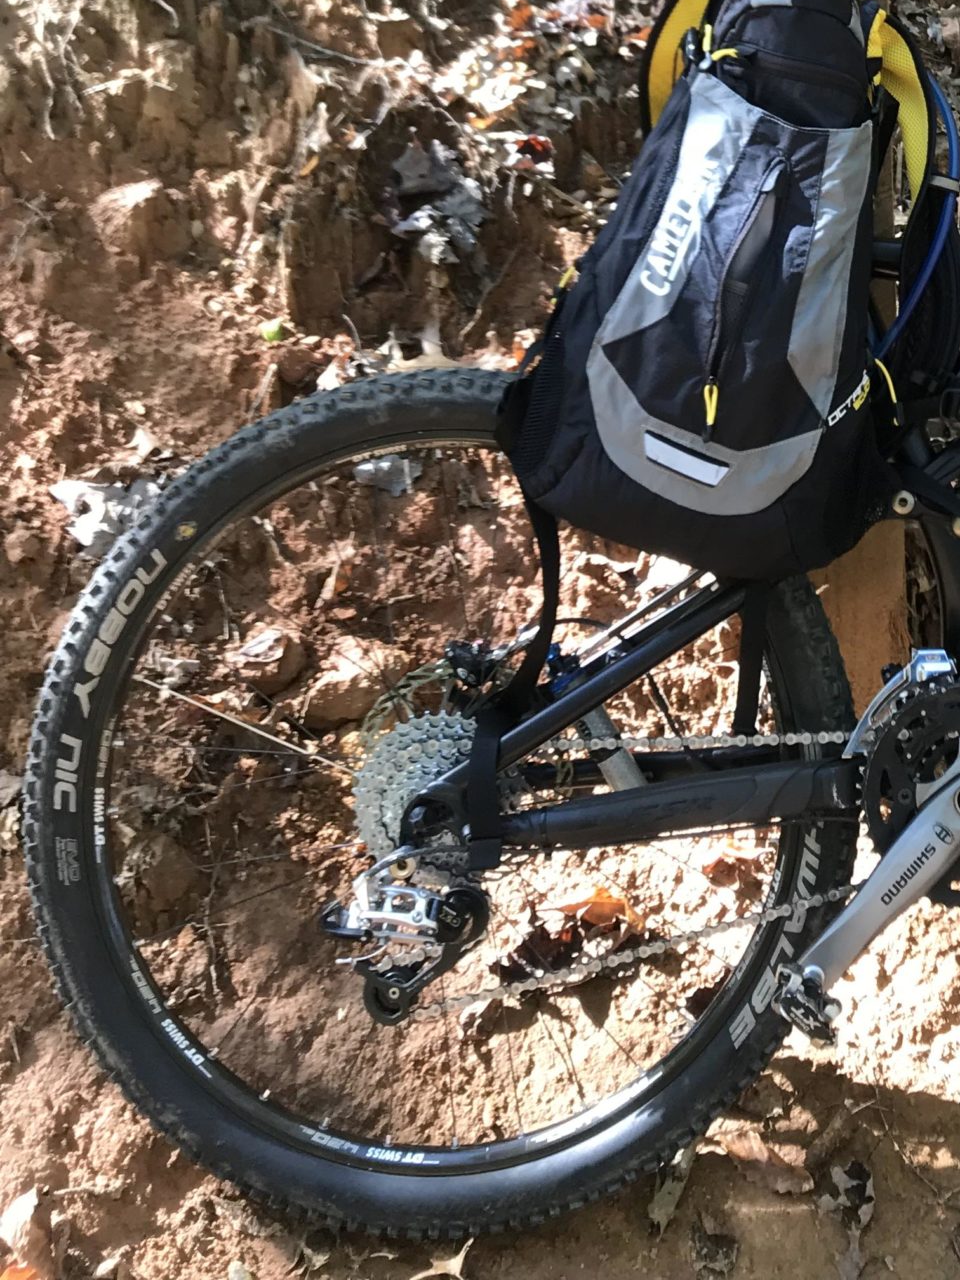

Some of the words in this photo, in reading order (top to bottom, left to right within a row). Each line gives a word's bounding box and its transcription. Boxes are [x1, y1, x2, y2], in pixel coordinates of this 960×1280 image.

[880, 842, 937, 907] SHIMANO
[161, 1018, 191, 1050] SWISS
[184, 1048, 206, 1066] DT
[365, 1146, 403, 1162] SWISS
[400, 1152, 426, 1165] DT
